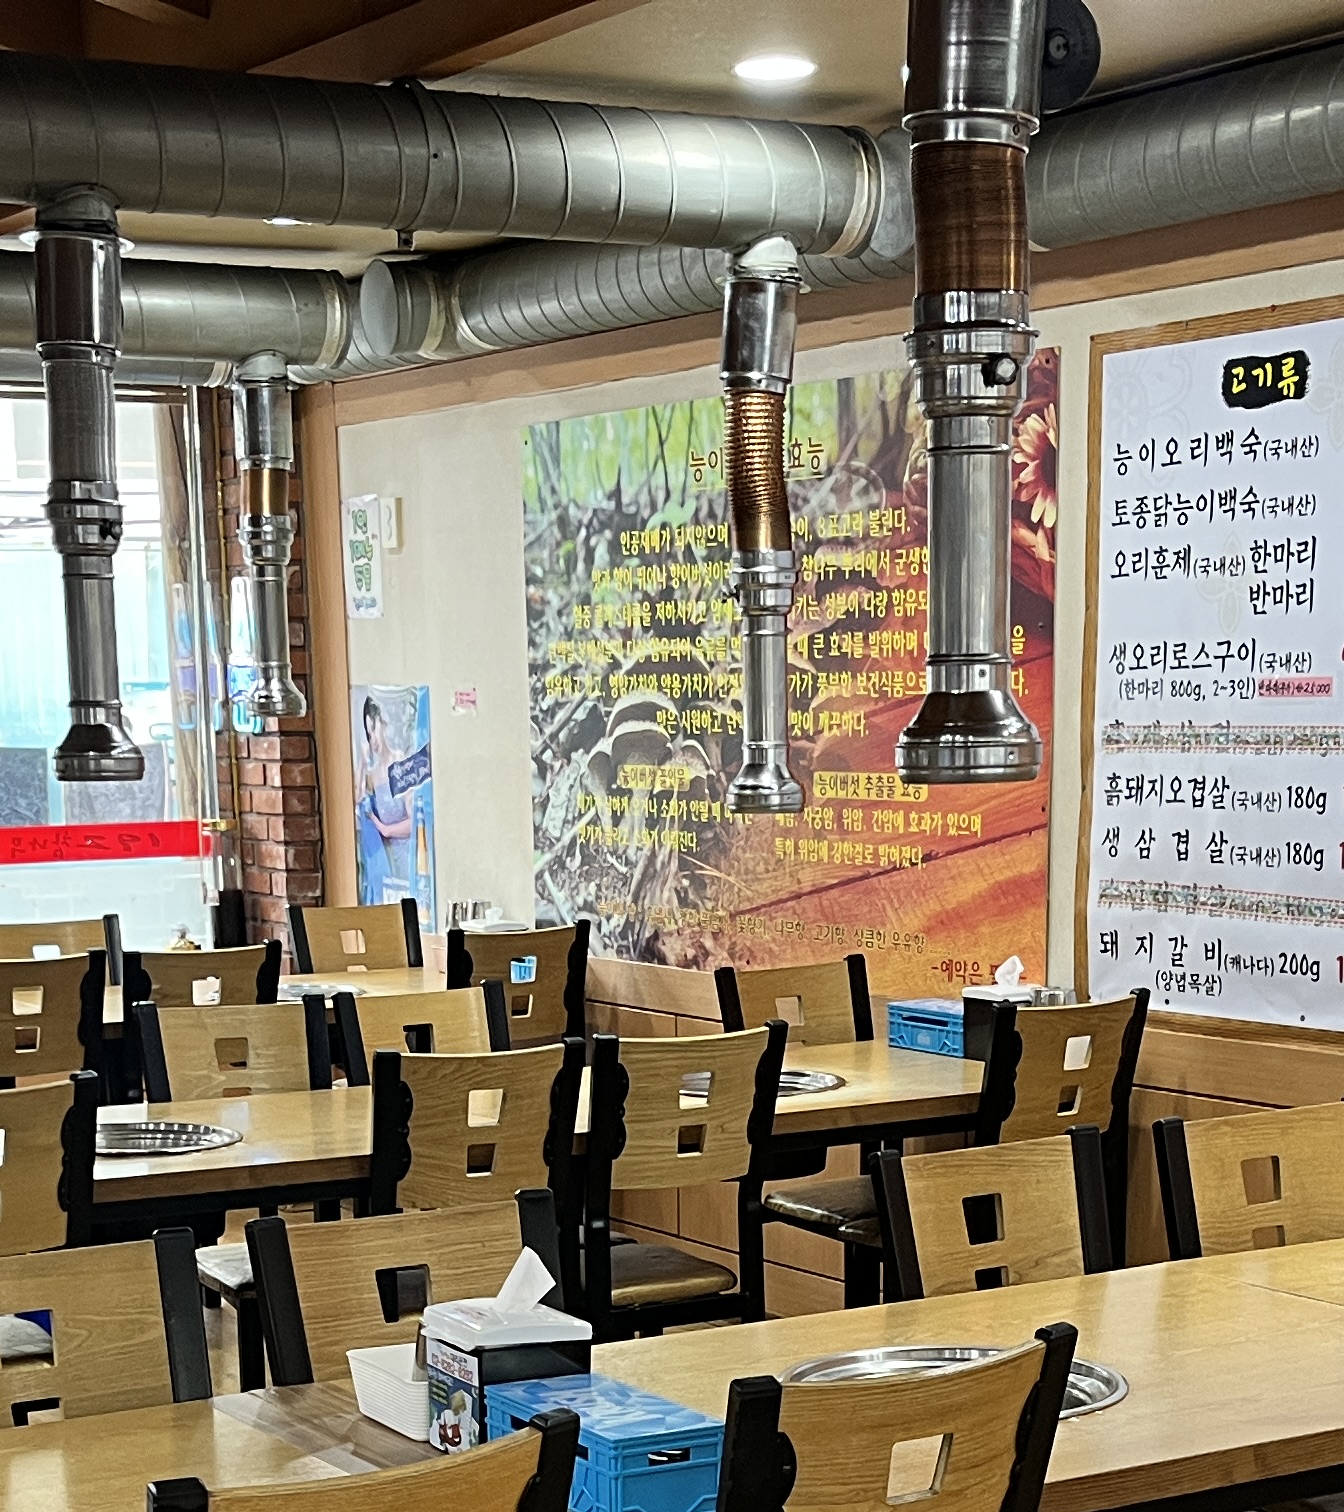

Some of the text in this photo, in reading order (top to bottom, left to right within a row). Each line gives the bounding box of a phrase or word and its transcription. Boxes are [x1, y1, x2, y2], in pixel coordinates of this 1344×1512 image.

[1230, 356, 1301, 398] 고기류
[788, 437, 824, 470] 효능
[869, 506, 911, 537] 불린다.
[1250, 536, 1316, 574] 한마리
[1248, 579, 1316, 617] 반마리
[828, 631, 864, 660] 효과를
[868, 628, 918, 658] 발휘하며
[817, 671, 852, 699] 풍부한
[1171, 680, 1205, 701] 800g,
[1212, 677, 1257, 701] 2~3인)
[790, 710, 813, 738] 맛이
[818, 710, 869, 738] 깨끗하다.
[818, 774, 860, 798] 능이버섯
[864, 776, 896, 800] 추출물
[1285, 783, 1327, 816] 180g
[872, 810, 904, 834] 간암에
[908, 810, 942, 837] 효과가
[947, 812, 982, 839] 있으며
[775, 837, 794, 861] 특히
[798, 838, 828, 863] 위암에
[1284, 841, 1325, 872] 180g
[1279, 952, 1320, 982] 200g
[1155, 968, 1223, 998] (양념목살)
